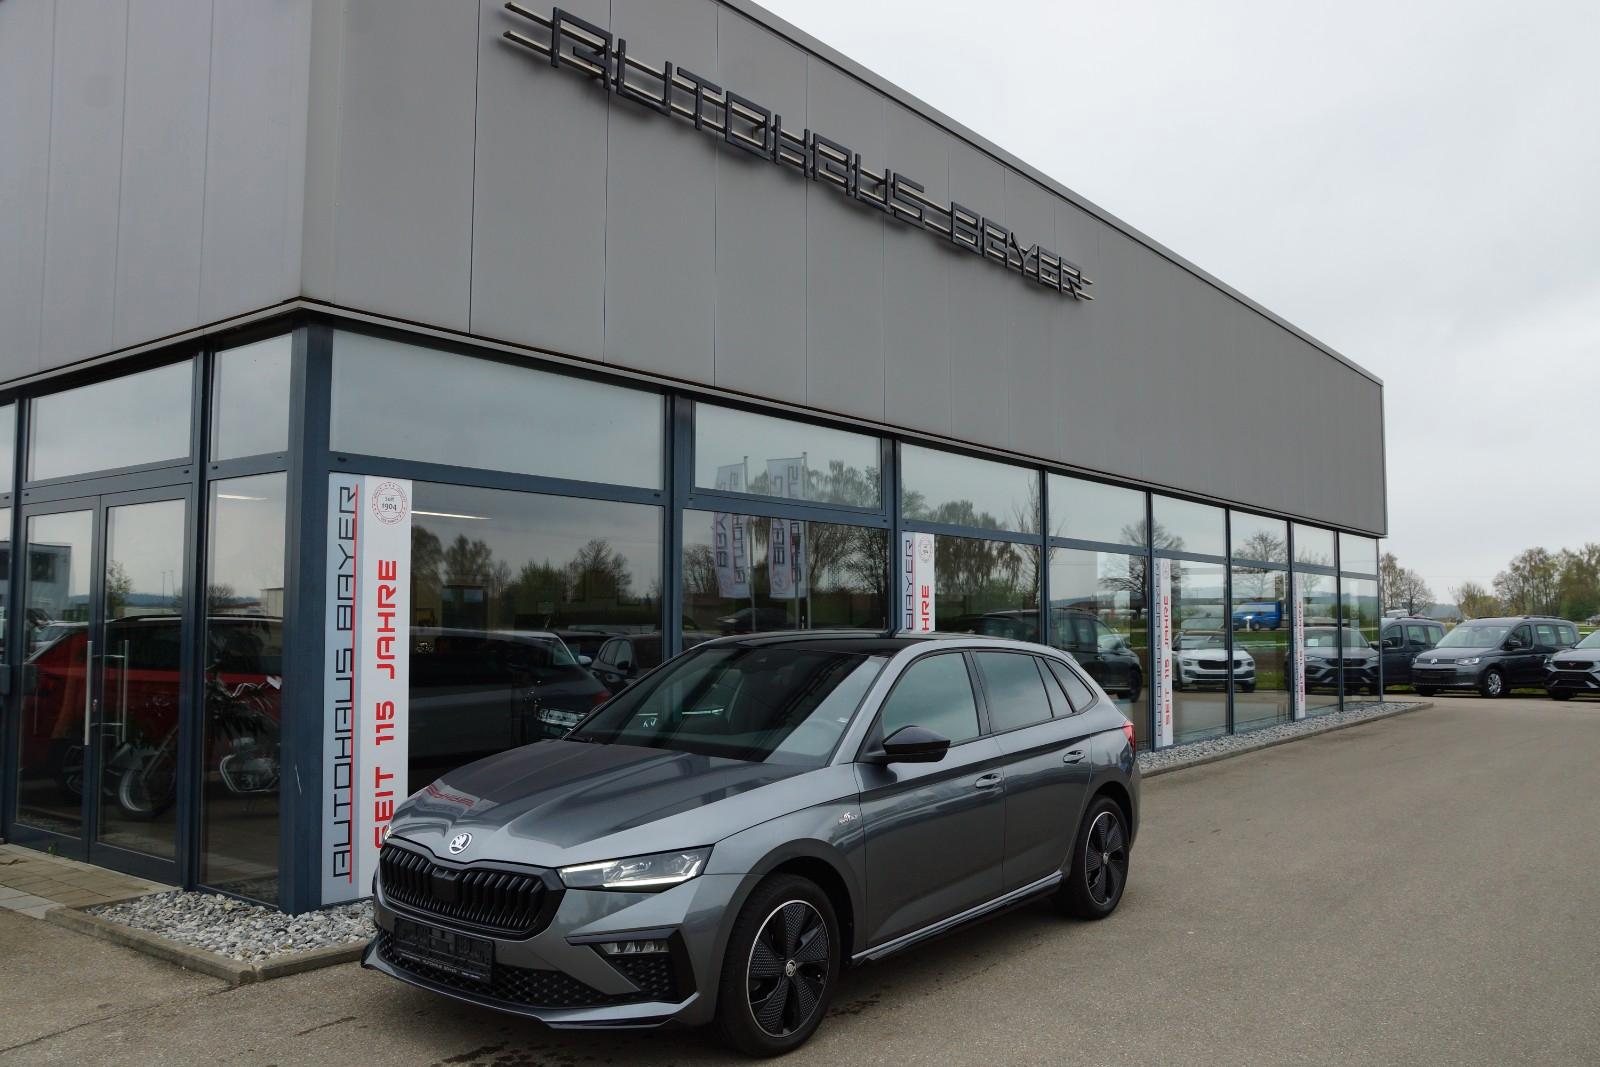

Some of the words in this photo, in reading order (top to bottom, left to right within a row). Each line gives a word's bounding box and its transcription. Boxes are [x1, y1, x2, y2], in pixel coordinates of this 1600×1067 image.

[551, 7, 925, 230] AUTOHAUS
[337, 486, 356, 631] BAYER
[381, 503, 397, 511] 1904
[376, 560, 397, 680] JAHRE
[905, 540, 914, 630] BAYER
[921, 585, 930, 631] HRE
[333, 648, 353, 877] AUTOHAUS
[375, 701, 395, 746] 115
